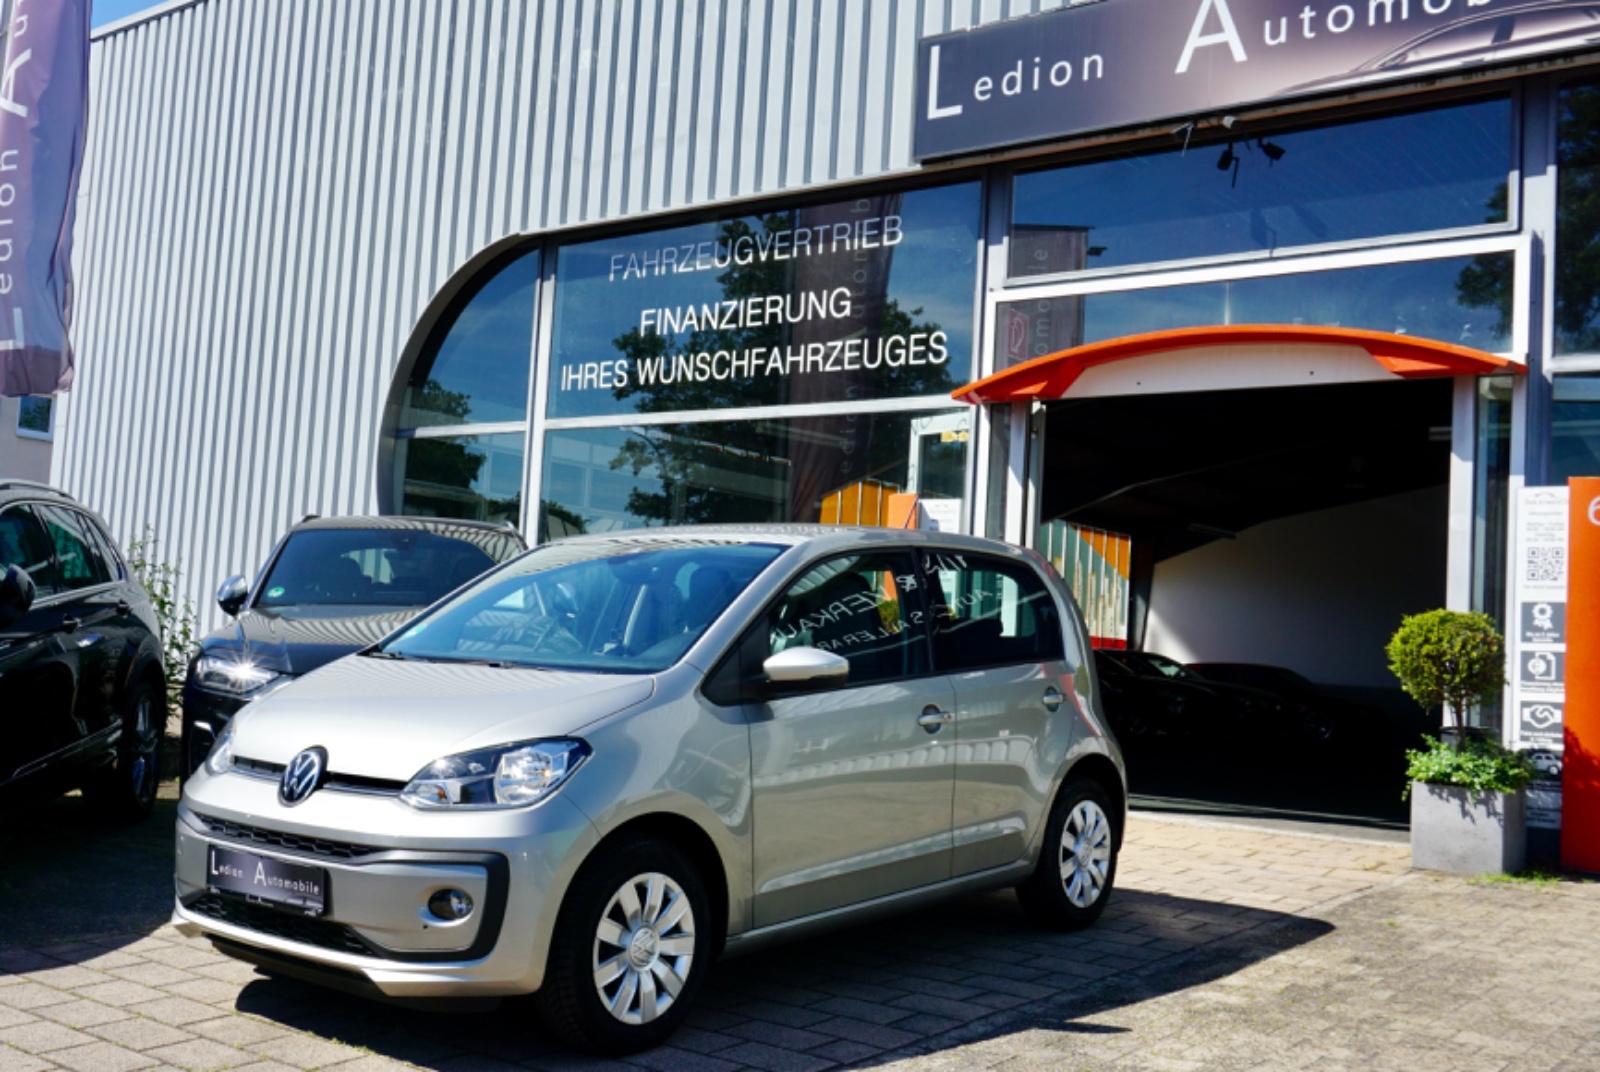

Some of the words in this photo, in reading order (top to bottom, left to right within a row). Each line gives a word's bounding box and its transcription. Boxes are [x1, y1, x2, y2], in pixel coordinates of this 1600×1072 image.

[927, 45, 1104, 120] Ledion
[608, 215, 903, 282] FAHRZEUGVERTRIEB
[640, 287, 852, 337] FINANZIERUNG
[560, 359, 628, 391] IHRES
[637, 331, 948, 386] WUNSCHFAHRZEUGES
[253, 861, 319, 896] Automobile
